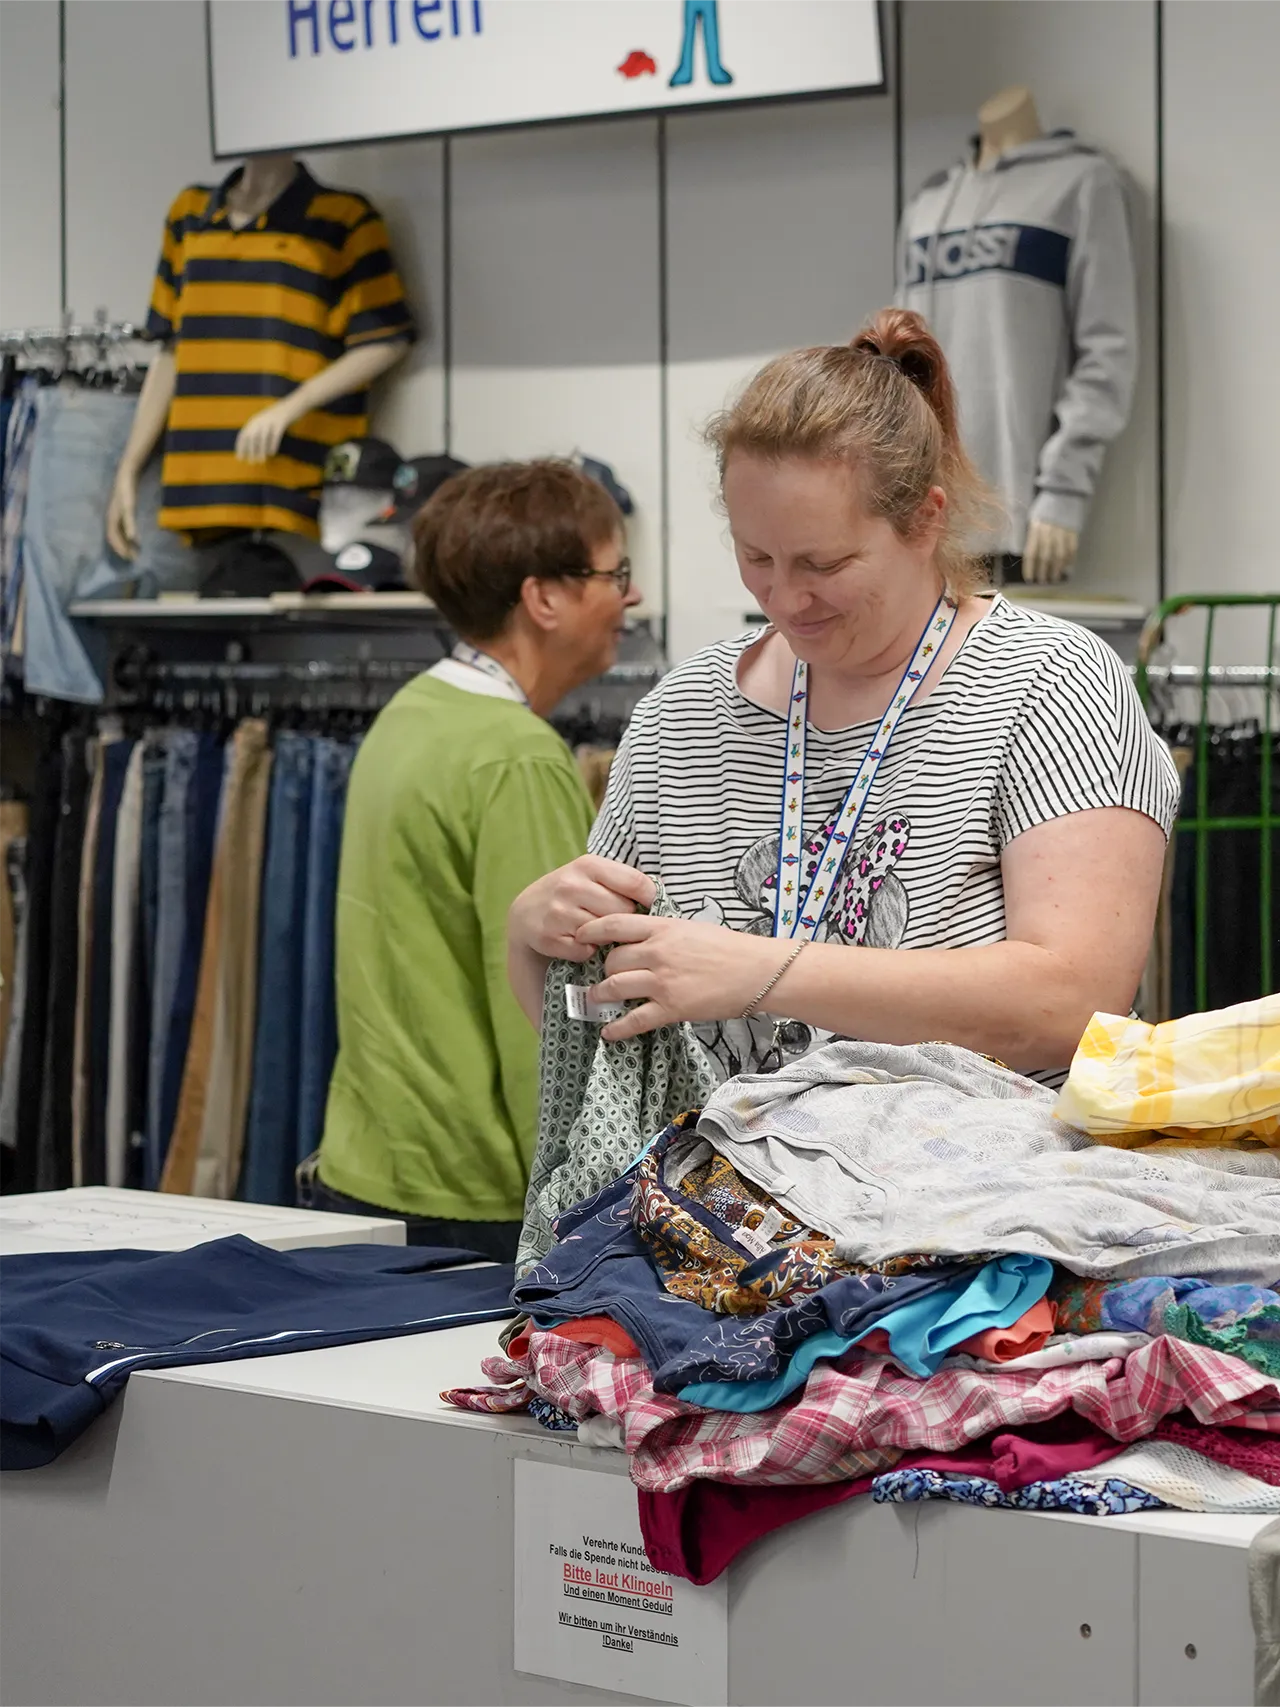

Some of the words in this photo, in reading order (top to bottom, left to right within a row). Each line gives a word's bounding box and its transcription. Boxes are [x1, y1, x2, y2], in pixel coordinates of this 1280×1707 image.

[286, 0, 482, 57] Herren
[549, 1544, 568, 1557] Falls
[569, 1548, 582, 1560] die
[584, 1551, 616, 1565] Spende
[618, 1557, 639, 1570] nicht
[582, 1535, 619, 1551] Verehrte
[620, 1542, 647, 1557] Kunde
[563, 1563, 592, 1582] Bitte
[596, 1568, 619, 1588] laut
[622, 1573, 673, 1597] Klingeln
[563, 1583, 580, 1596] Und
[582, 1588, 605, 1600] einen
[607, 1591, 641, 1607] Moment
[642, 1599, 673, 1614] Geduld
[558, 1611, 572, 1624] Wir
[573, 1615, 598, 1629] bitten
[600, 1620, 613, 1631] um
[614, 1622, 627, 1634] ihr
[627, 1625, 679, 1645] Verständnis
[602, 1634, 634, 1651] !Danke!
